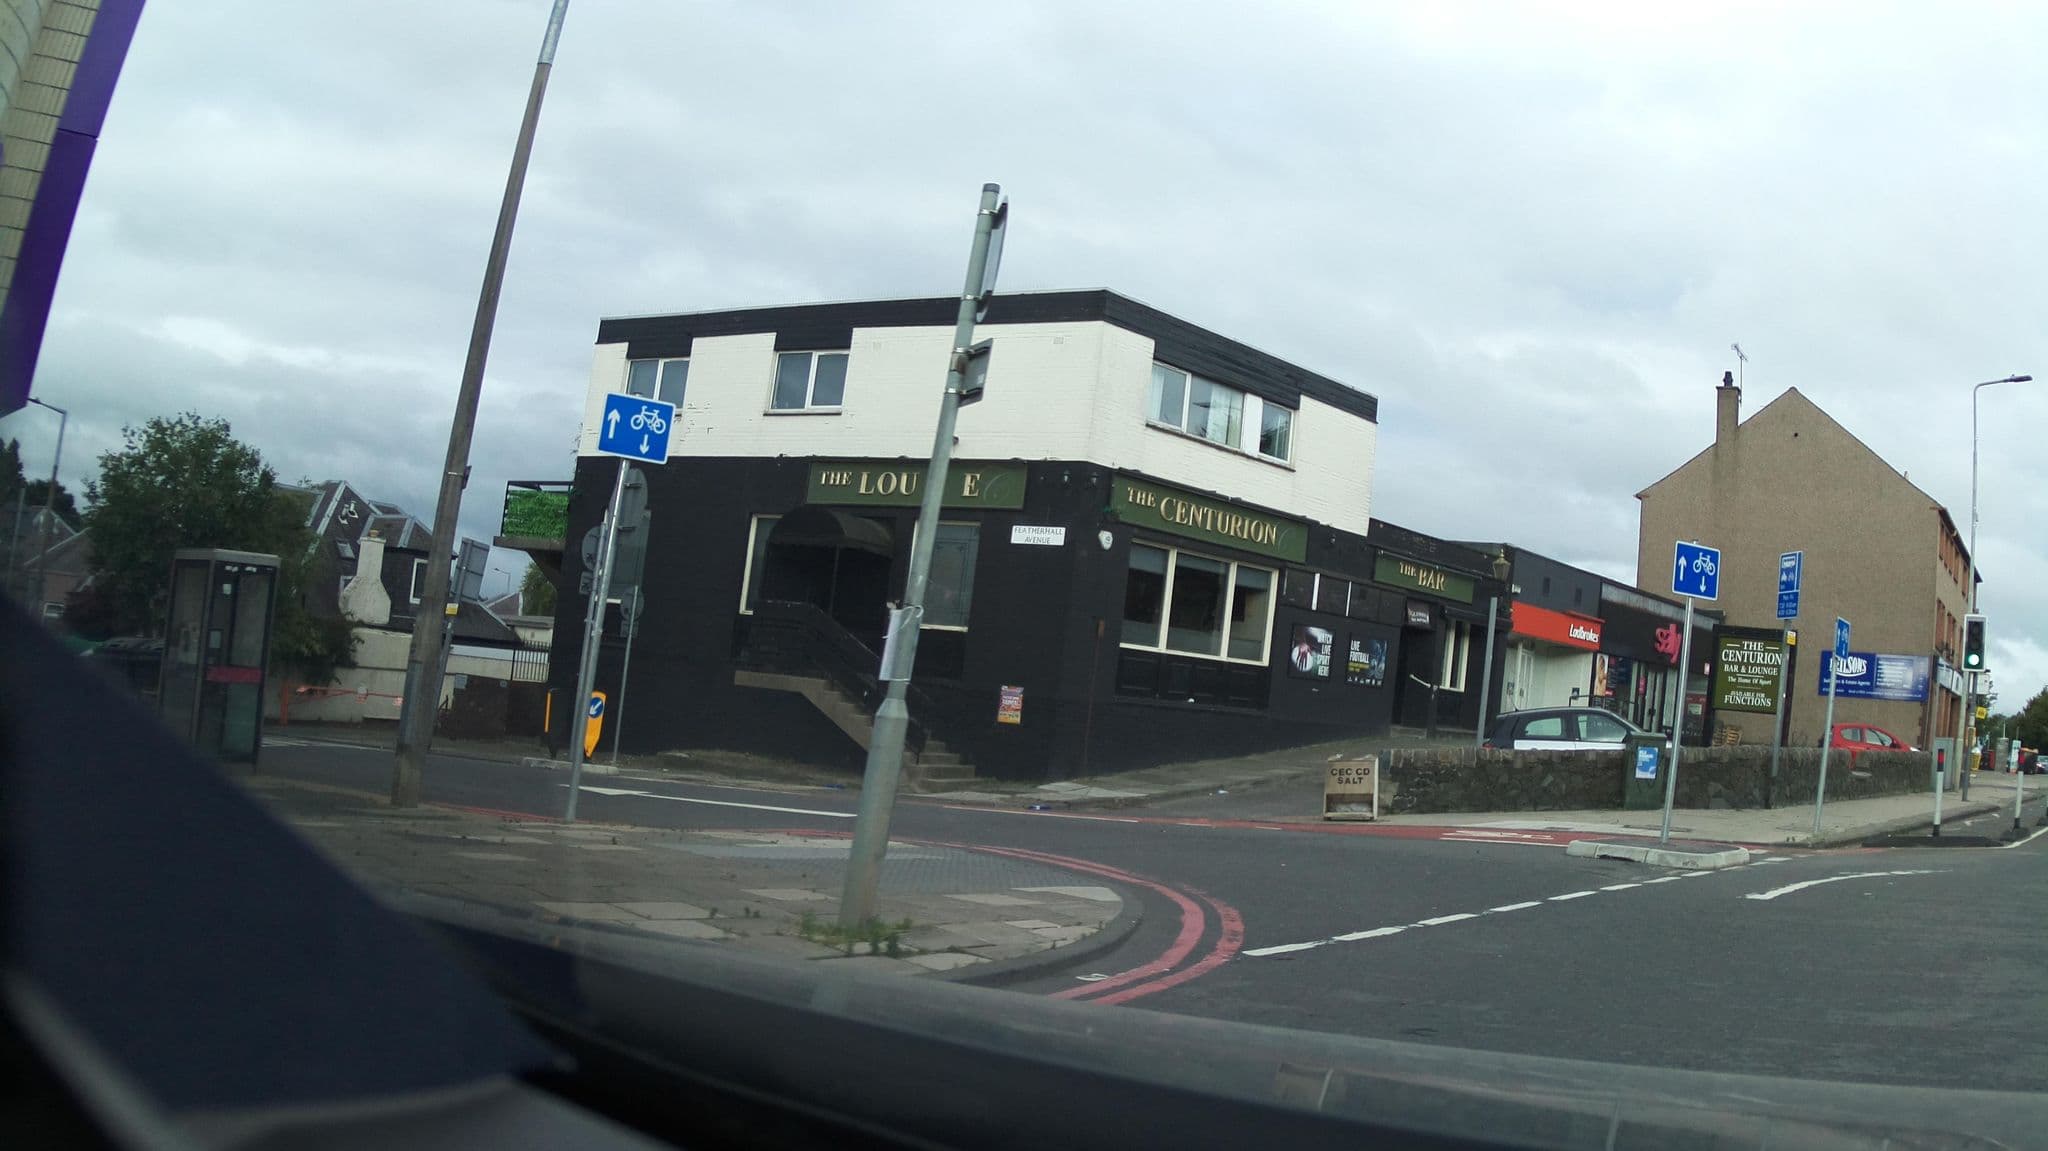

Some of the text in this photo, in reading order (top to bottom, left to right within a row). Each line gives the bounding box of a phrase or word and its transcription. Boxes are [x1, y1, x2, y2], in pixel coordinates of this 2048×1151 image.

[820, 471, 852, 486] THE
[1127, 486, 1278, 546] THE CENTURION
[1024, 536, 1052, 544] AVENUE
[1399, 562, 1446, 591] THE BAR
[1569, 624, 1600, 643] Ladbrokes
[1322, 644, 1332, 655] LIVE
[1351, 639, 1361, 651] LIVE
[1742, 640, 1764, 651] THE
[1349, 651, 1370, 664] FOOTBALL
[1722, 649, 1783, 665] CENTURION
[1724, 664, 1779, 676] BAR & LOUNGE
[1724, 695, 1772, 707] FUNCTIONS
[1330, 768, 1353, 776] CEC
[1337, 777, 1364, 785] SALT
